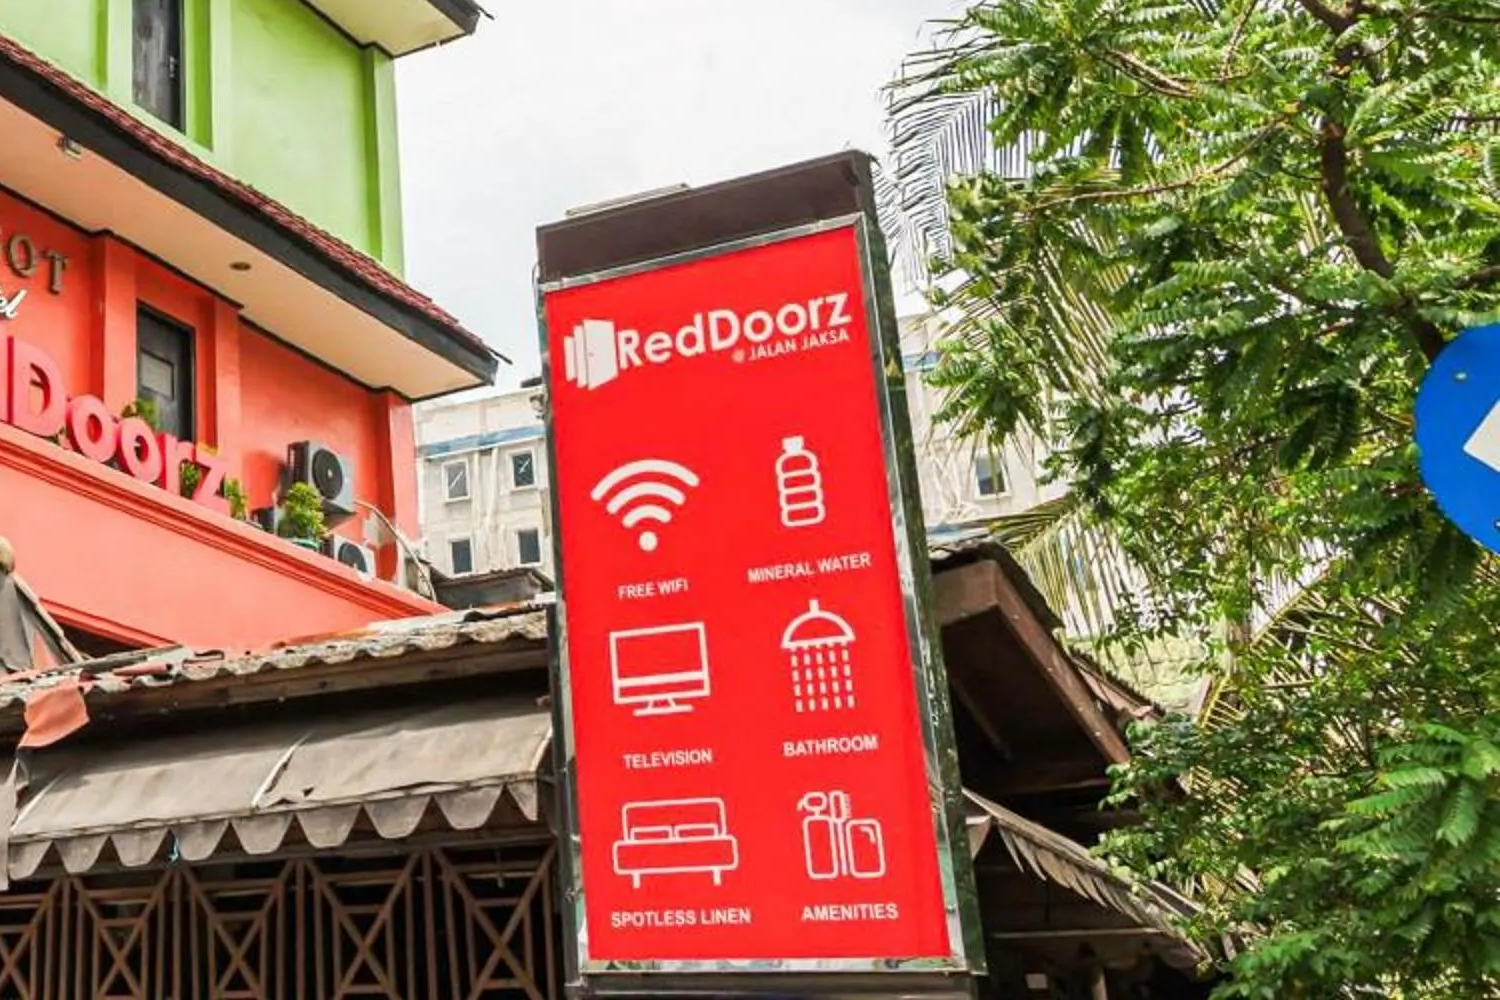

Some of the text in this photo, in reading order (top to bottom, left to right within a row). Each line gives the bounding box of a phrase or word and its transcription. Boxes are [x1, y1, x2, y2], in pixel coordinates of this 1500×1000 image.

[617, 292, 852, 369] RedDoorz
[748, 342, 797, 362] JALAN
[800, 329, 849, 350] JAKSA
[747, 552, 871, 583] MINERAL WATER
[618, 578, 688, 600] FREE WIFI
[782, 734, 879, 757] BATHROOM
[623, 748, 713, 769] TELEVISION
[611, 907, 751, 928] SPOTLESS LINEN
[801, 903, 899, 921] AMENITIES
